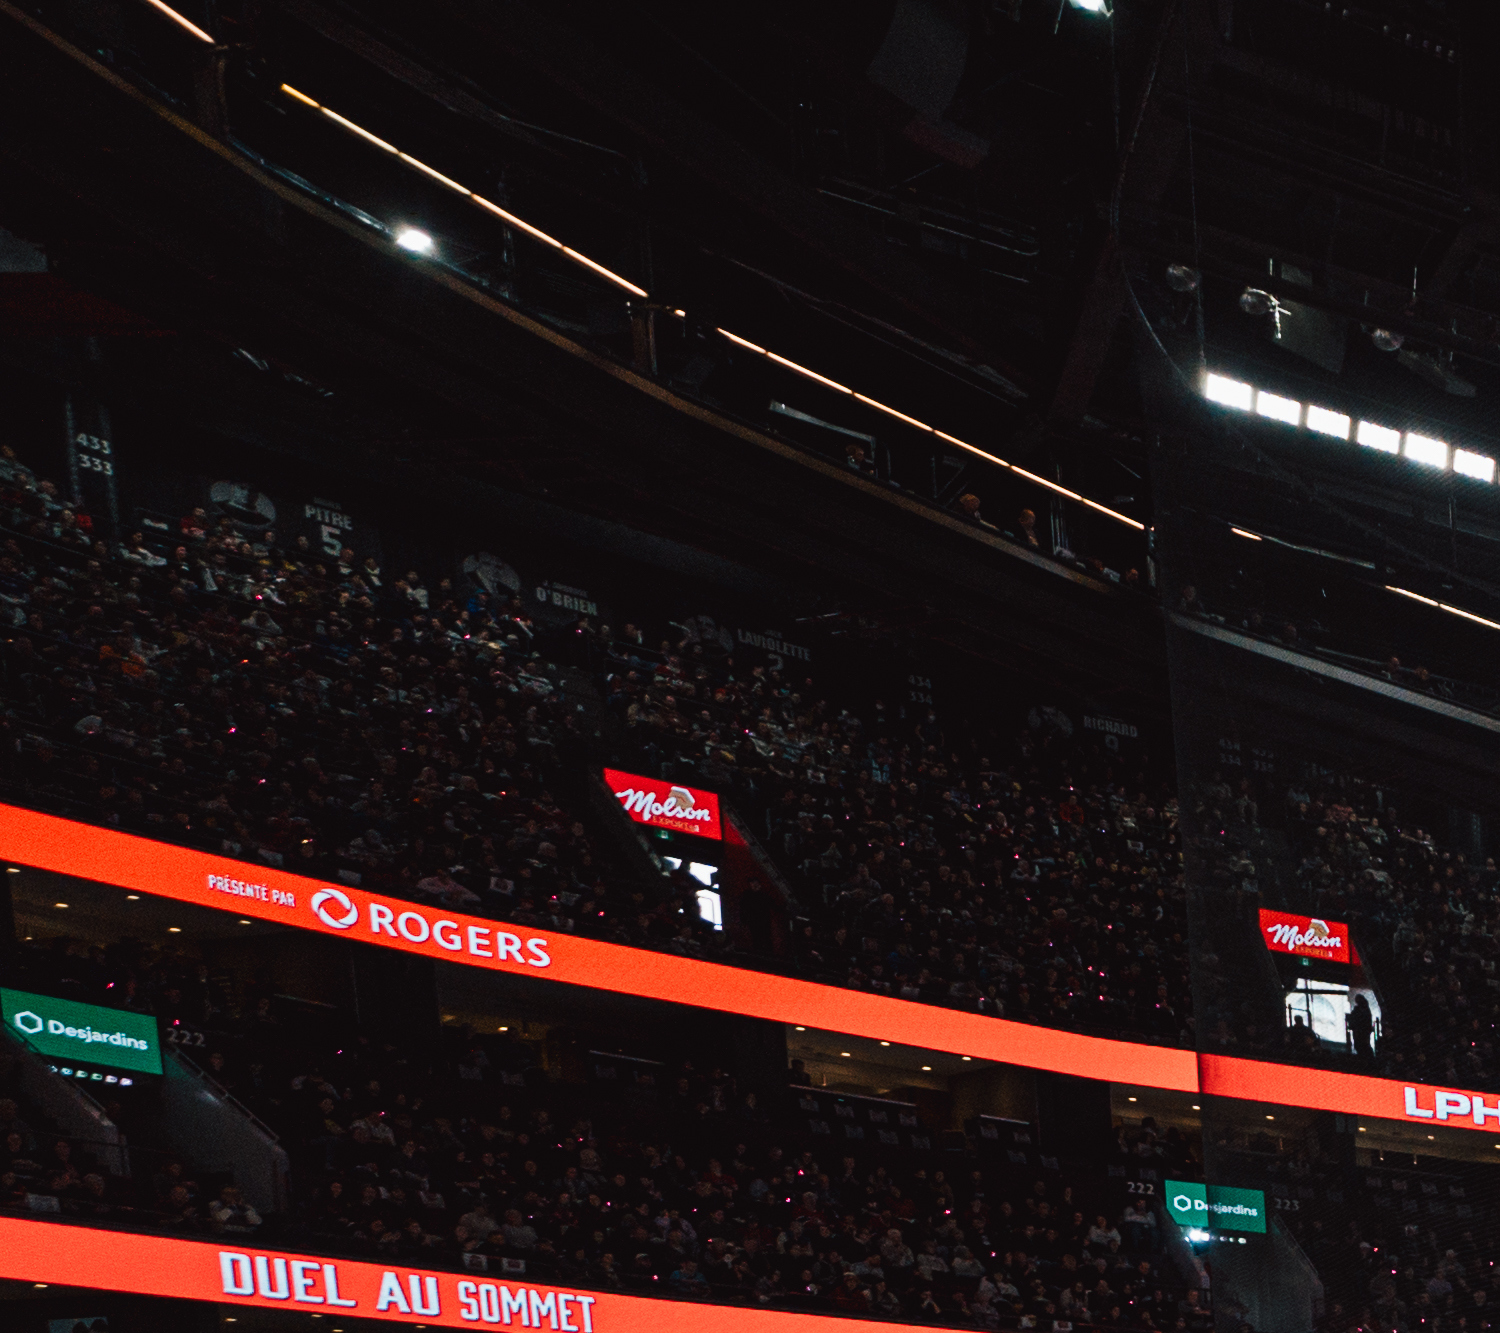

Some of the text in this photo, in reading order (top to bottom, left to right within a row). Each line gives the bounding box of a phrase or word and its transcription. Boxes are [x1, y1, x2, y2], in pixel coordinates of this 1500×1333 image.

[615, 788, 711, 821] Molson
[208, 874, 295, 908] PRÉSENTÉ PAR
[369, 902, 551, 967] ROGERS
[1267, 923, 1342, 950] Molson
[47, 1019, 148, 1050] Desjardins
[166, 1028, 206, 1047] 222
[1127, 1181, 1155, 1195] 222
[218, 1251, 595, 1333] DUEL AU SOMMET
